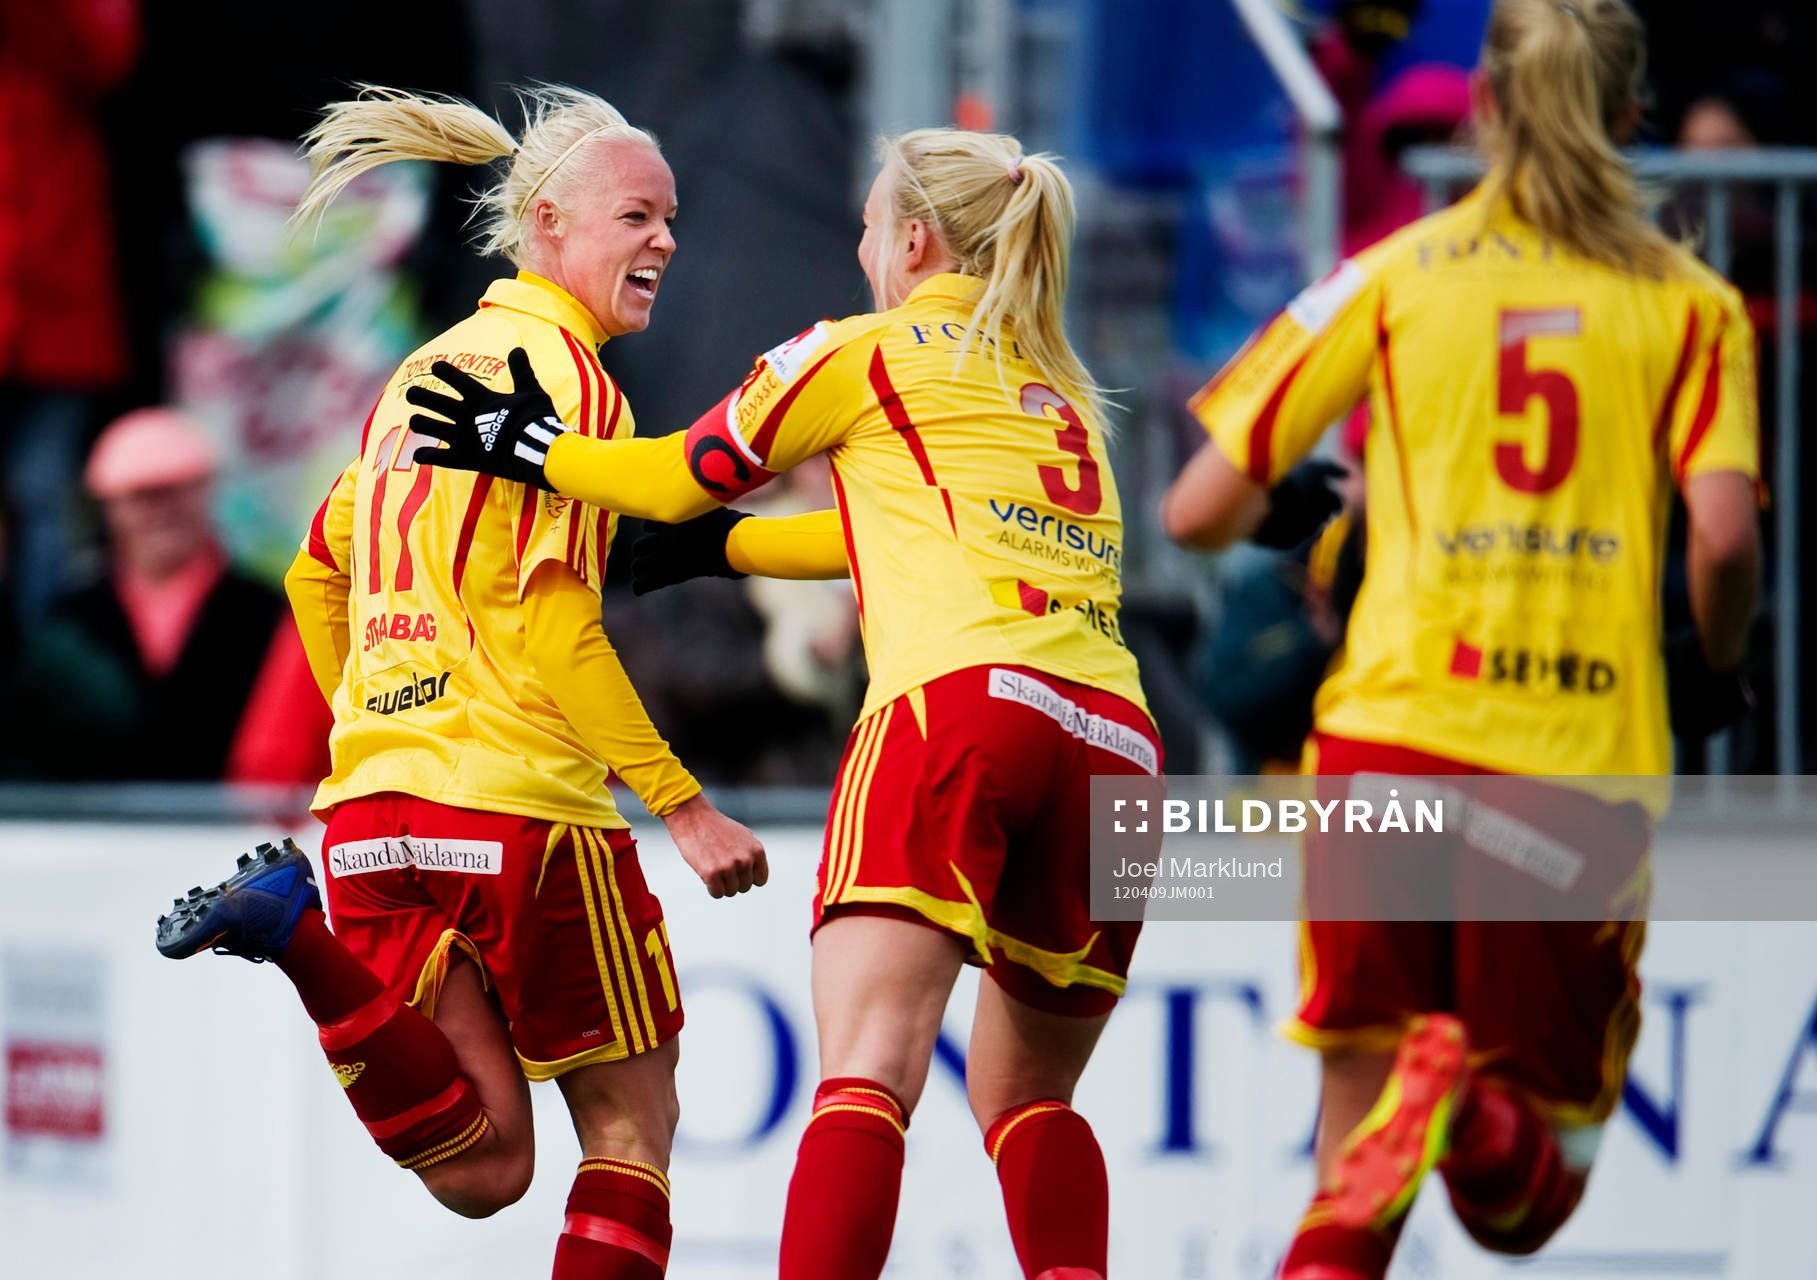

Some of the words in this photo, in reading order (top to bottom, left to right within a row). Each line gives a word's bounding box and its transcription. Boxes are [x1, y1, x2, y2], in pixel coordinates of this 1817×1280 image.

[450, 352, 507, 377] CENTER
[484, 407, 510, 452] adidas
[1494, 308, 1581, 496] 5
[690, 434, 750, 493] C
[1019, 381, 1103, 516] 3
[368, 424, 442, 596] 17
[998, 530, 1071, 567] ALARMS
